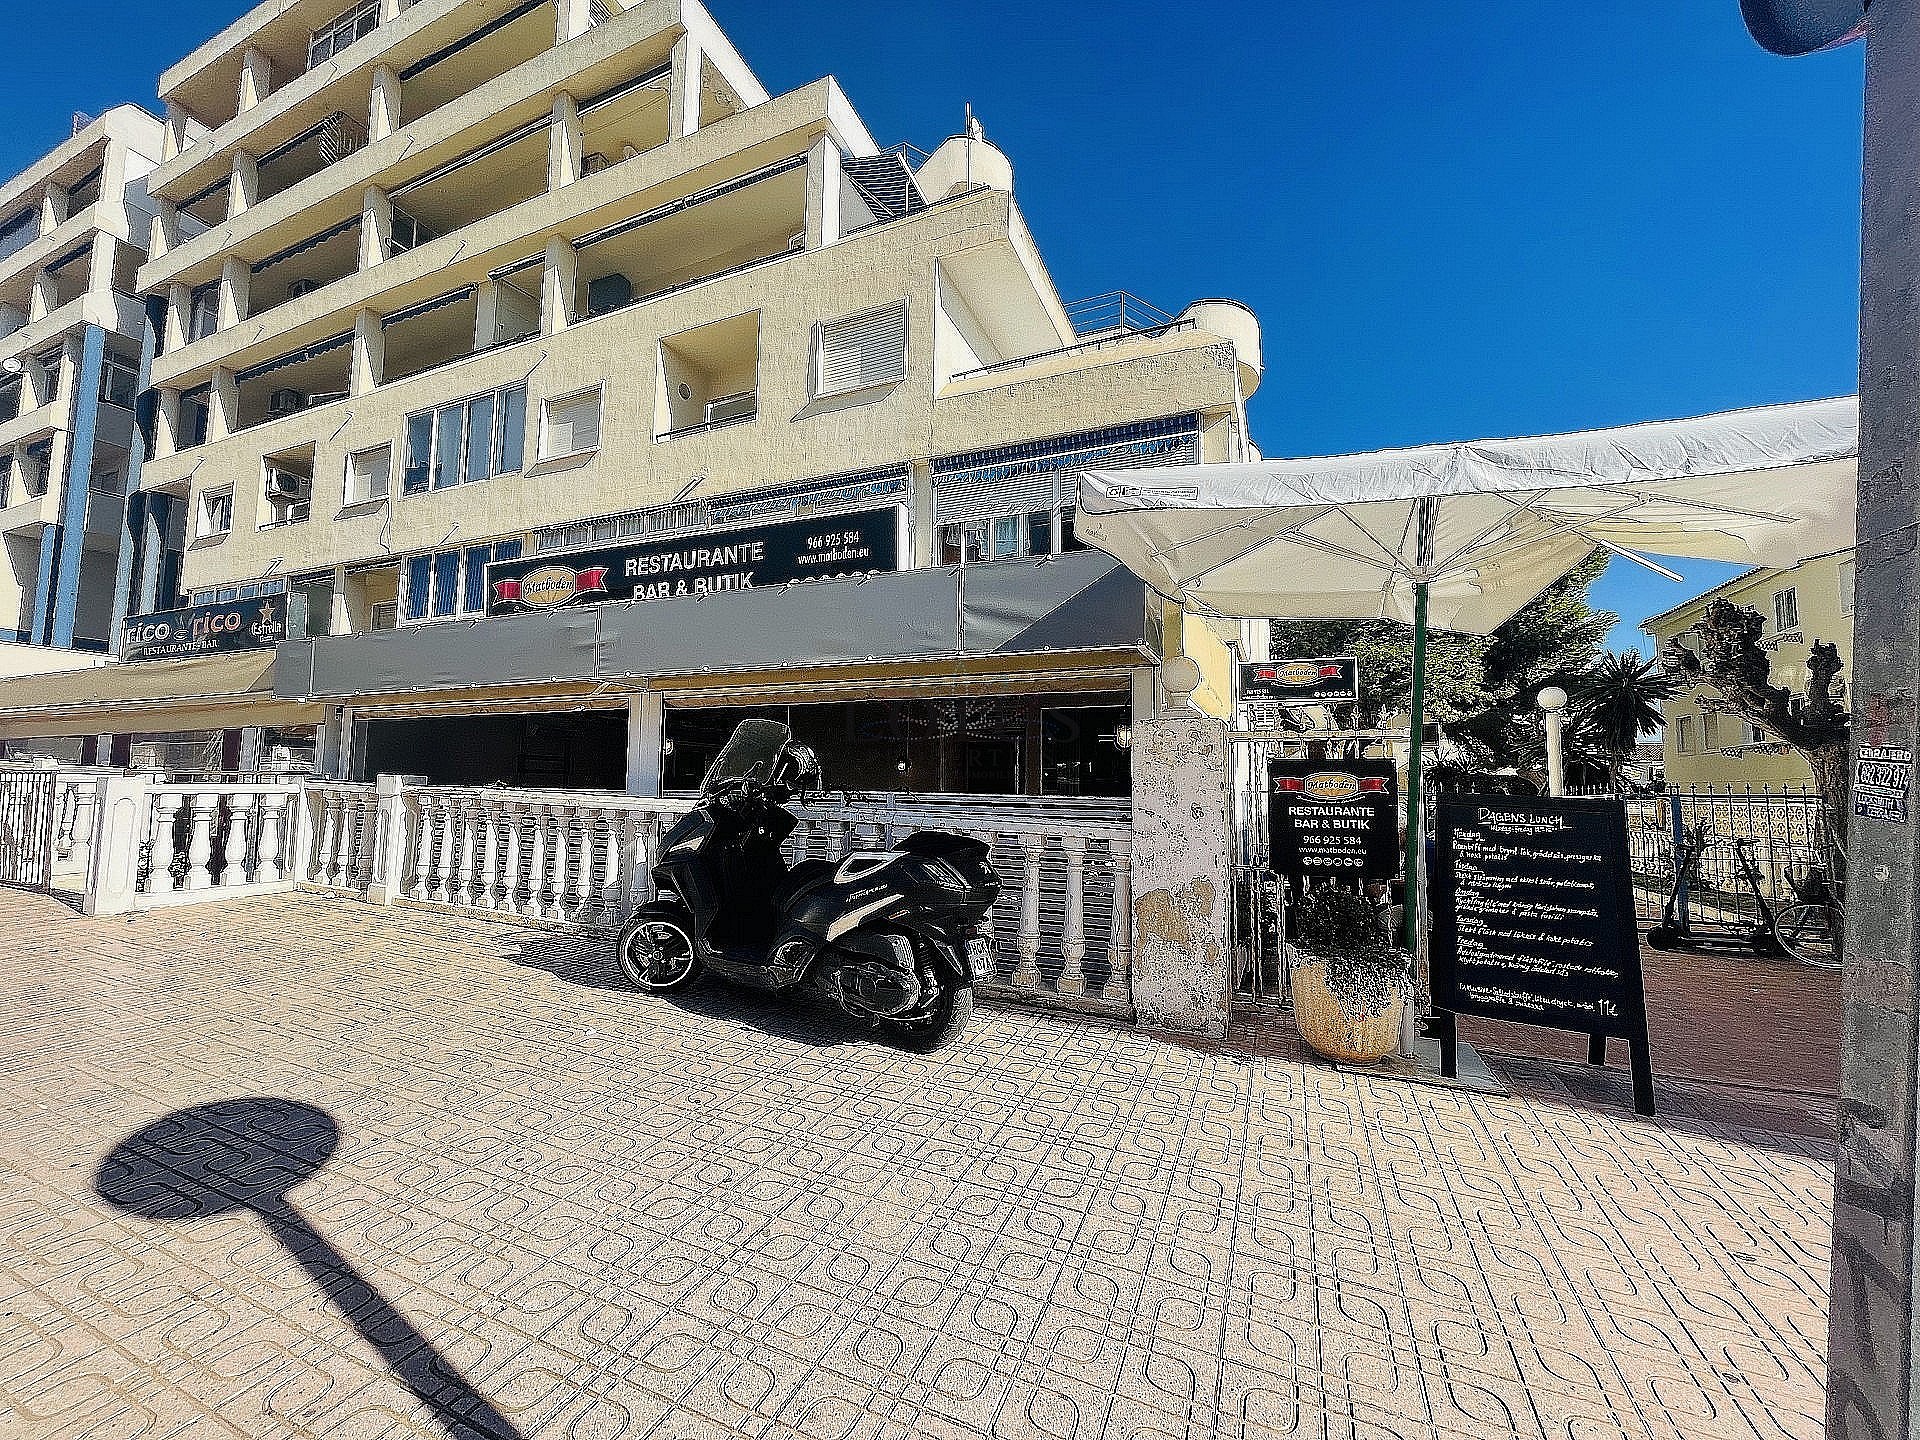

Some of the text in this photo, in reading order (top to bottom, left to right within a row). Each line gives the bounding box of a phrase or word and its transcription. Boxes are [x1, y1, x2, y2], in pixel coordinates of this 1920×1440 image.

[807, 530, 860, 549] 966 925 584
[624, 541, 764, 577] RESTAURANTE
[798, 546, 870, 565] www.matboden.eu
[524, 573, 575, 597] Matboden
[633, 571, 755, 602] BAR & BUTIK
[126, 612, 241, 645] rico rico
[143, 640, 218, 656] RESTAURANTE BAR
[1278, 668, 1318, 678] Matboden
[1306, 779, 1356, 792] Matboden
[1288, 806, 1375, 817] RESTAURANTE
[1478, 807, 1563, 829] DAGENS LUNCH
[1294, 819, 1370, 830] BAR & BUTIK
[1303, 835, 1361, 846] 966 925 584
[1298, 846, 1367, 855] www.matboden.eu
